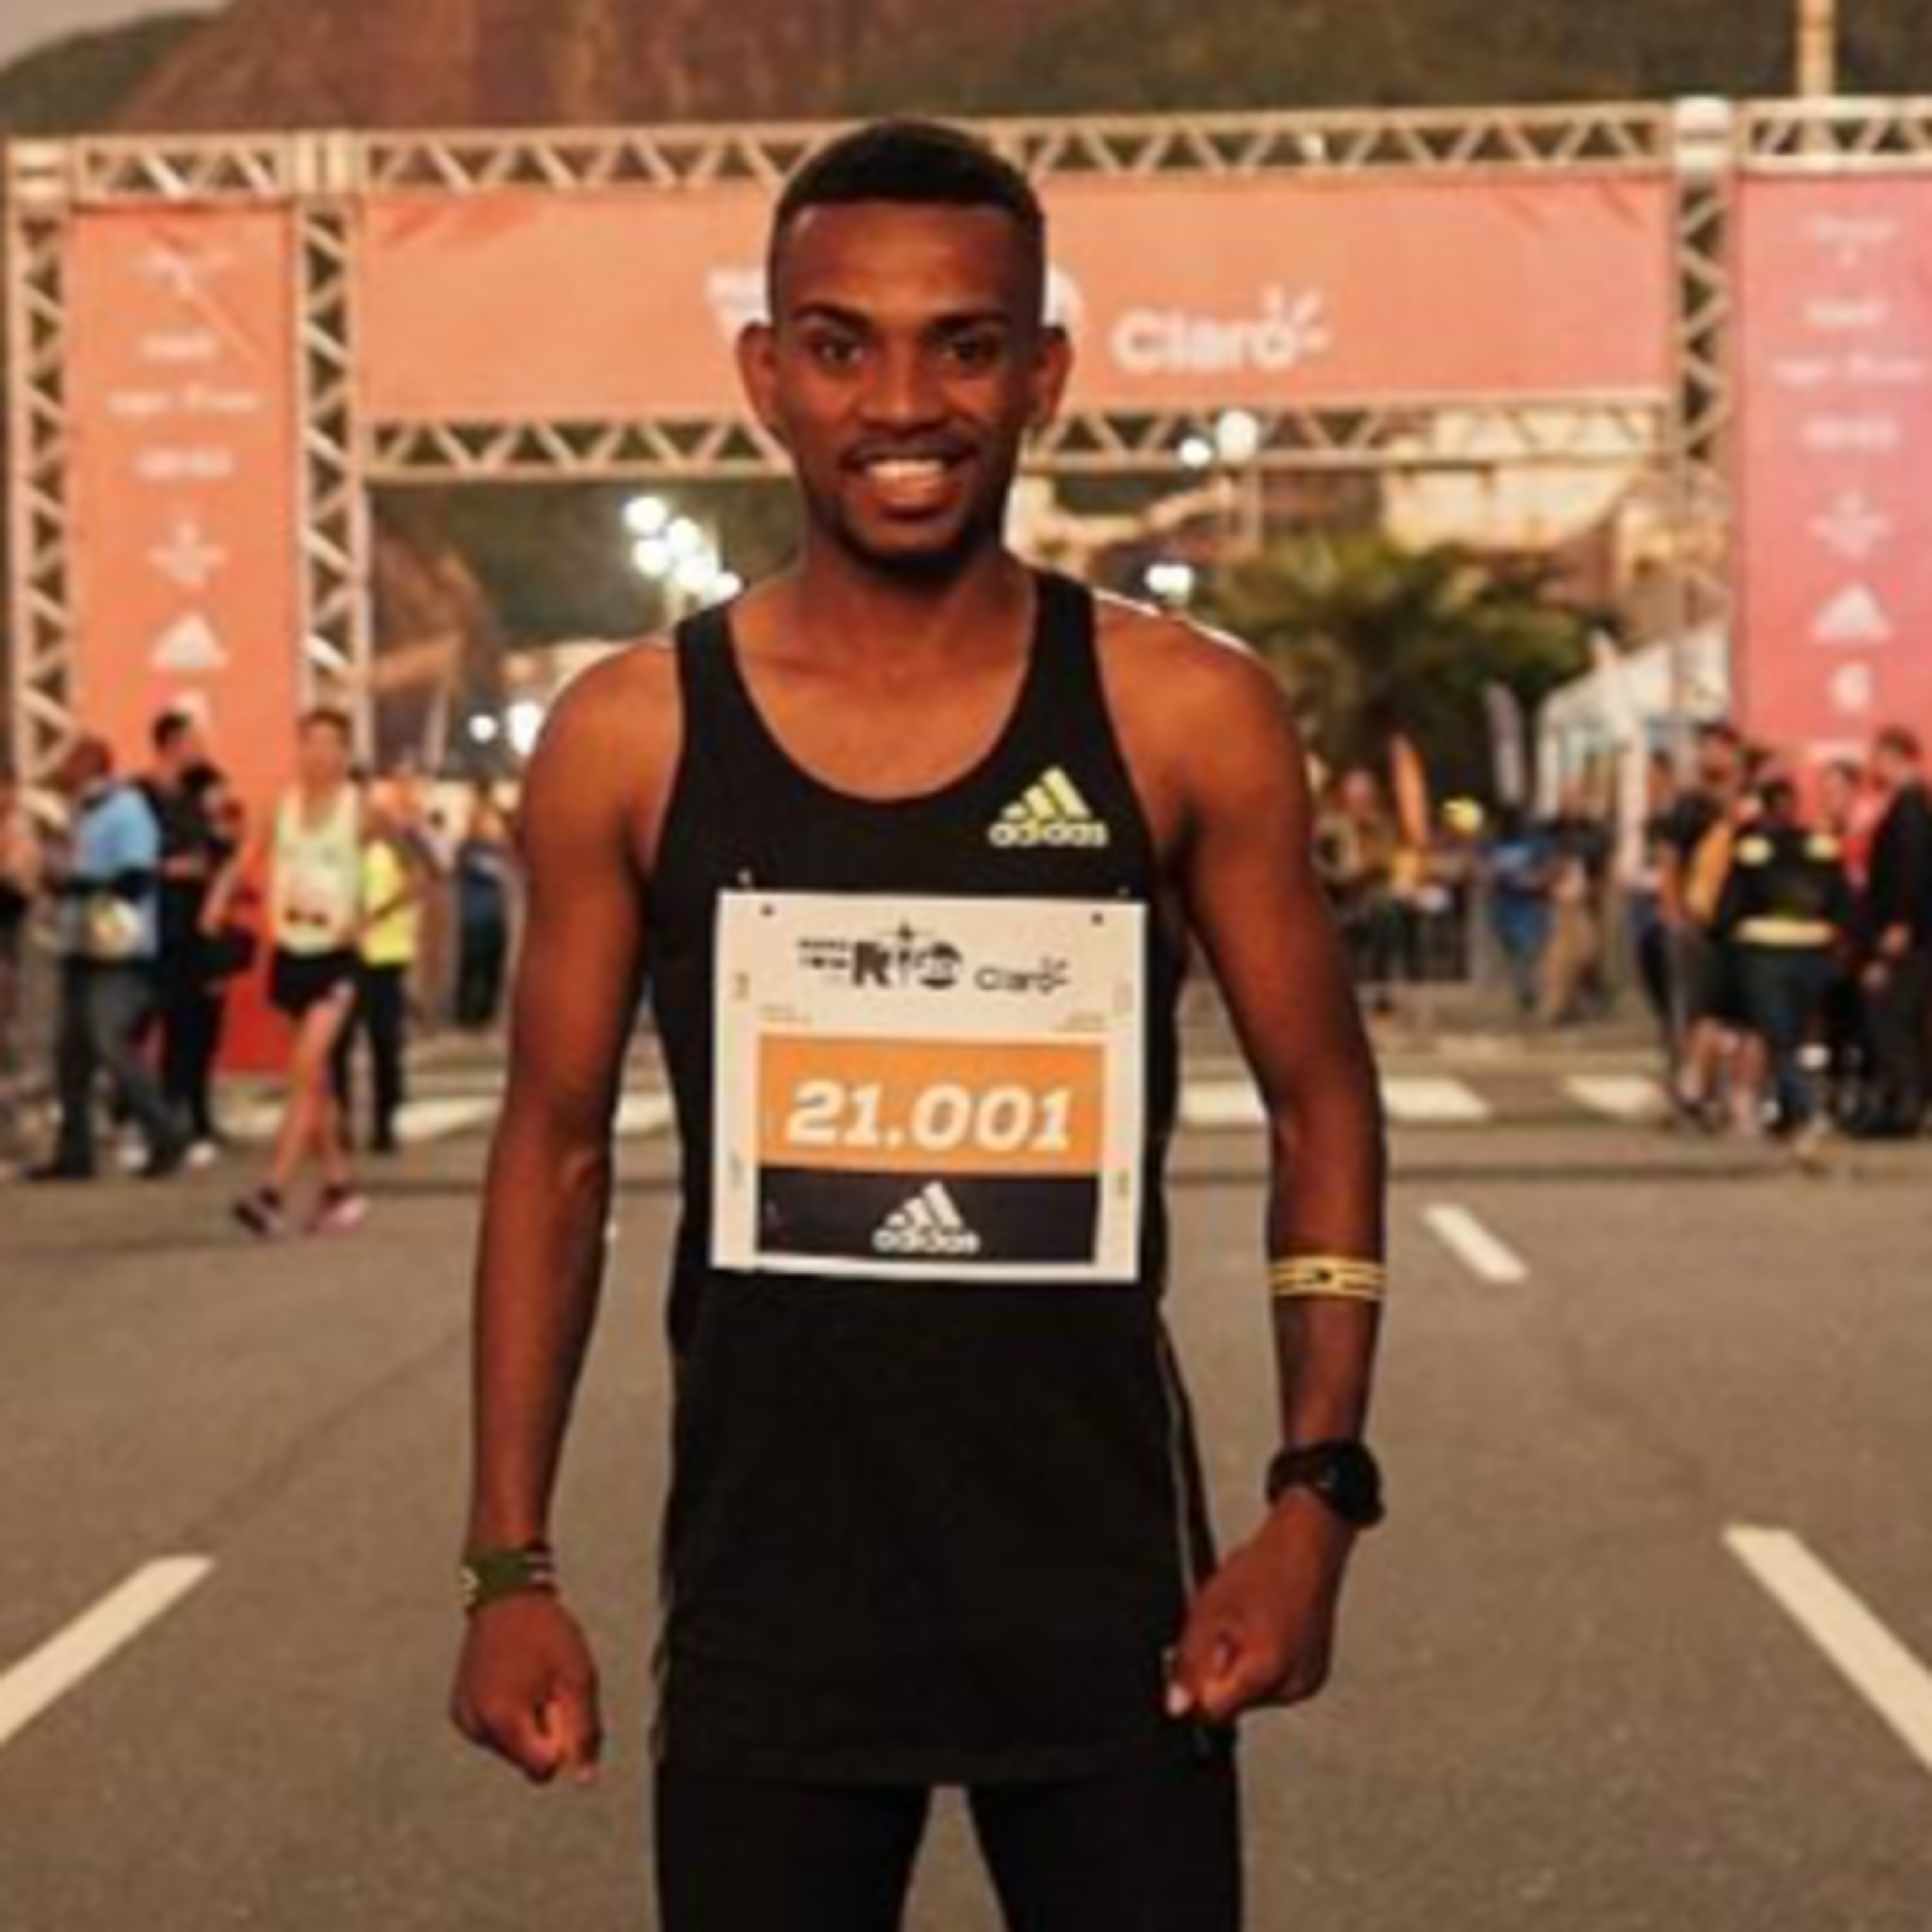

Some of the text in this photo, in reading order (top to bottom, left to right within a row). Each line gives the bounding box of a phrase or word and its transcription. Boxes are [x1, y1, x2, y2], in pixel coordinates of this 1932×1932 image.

[1112, 305, 1306, 374] Claro
[989, 817, 1110, 848] adidas
[786, 1079, 1072, 1153] 21.001
[871, 1225, 981, 1254] adidas
